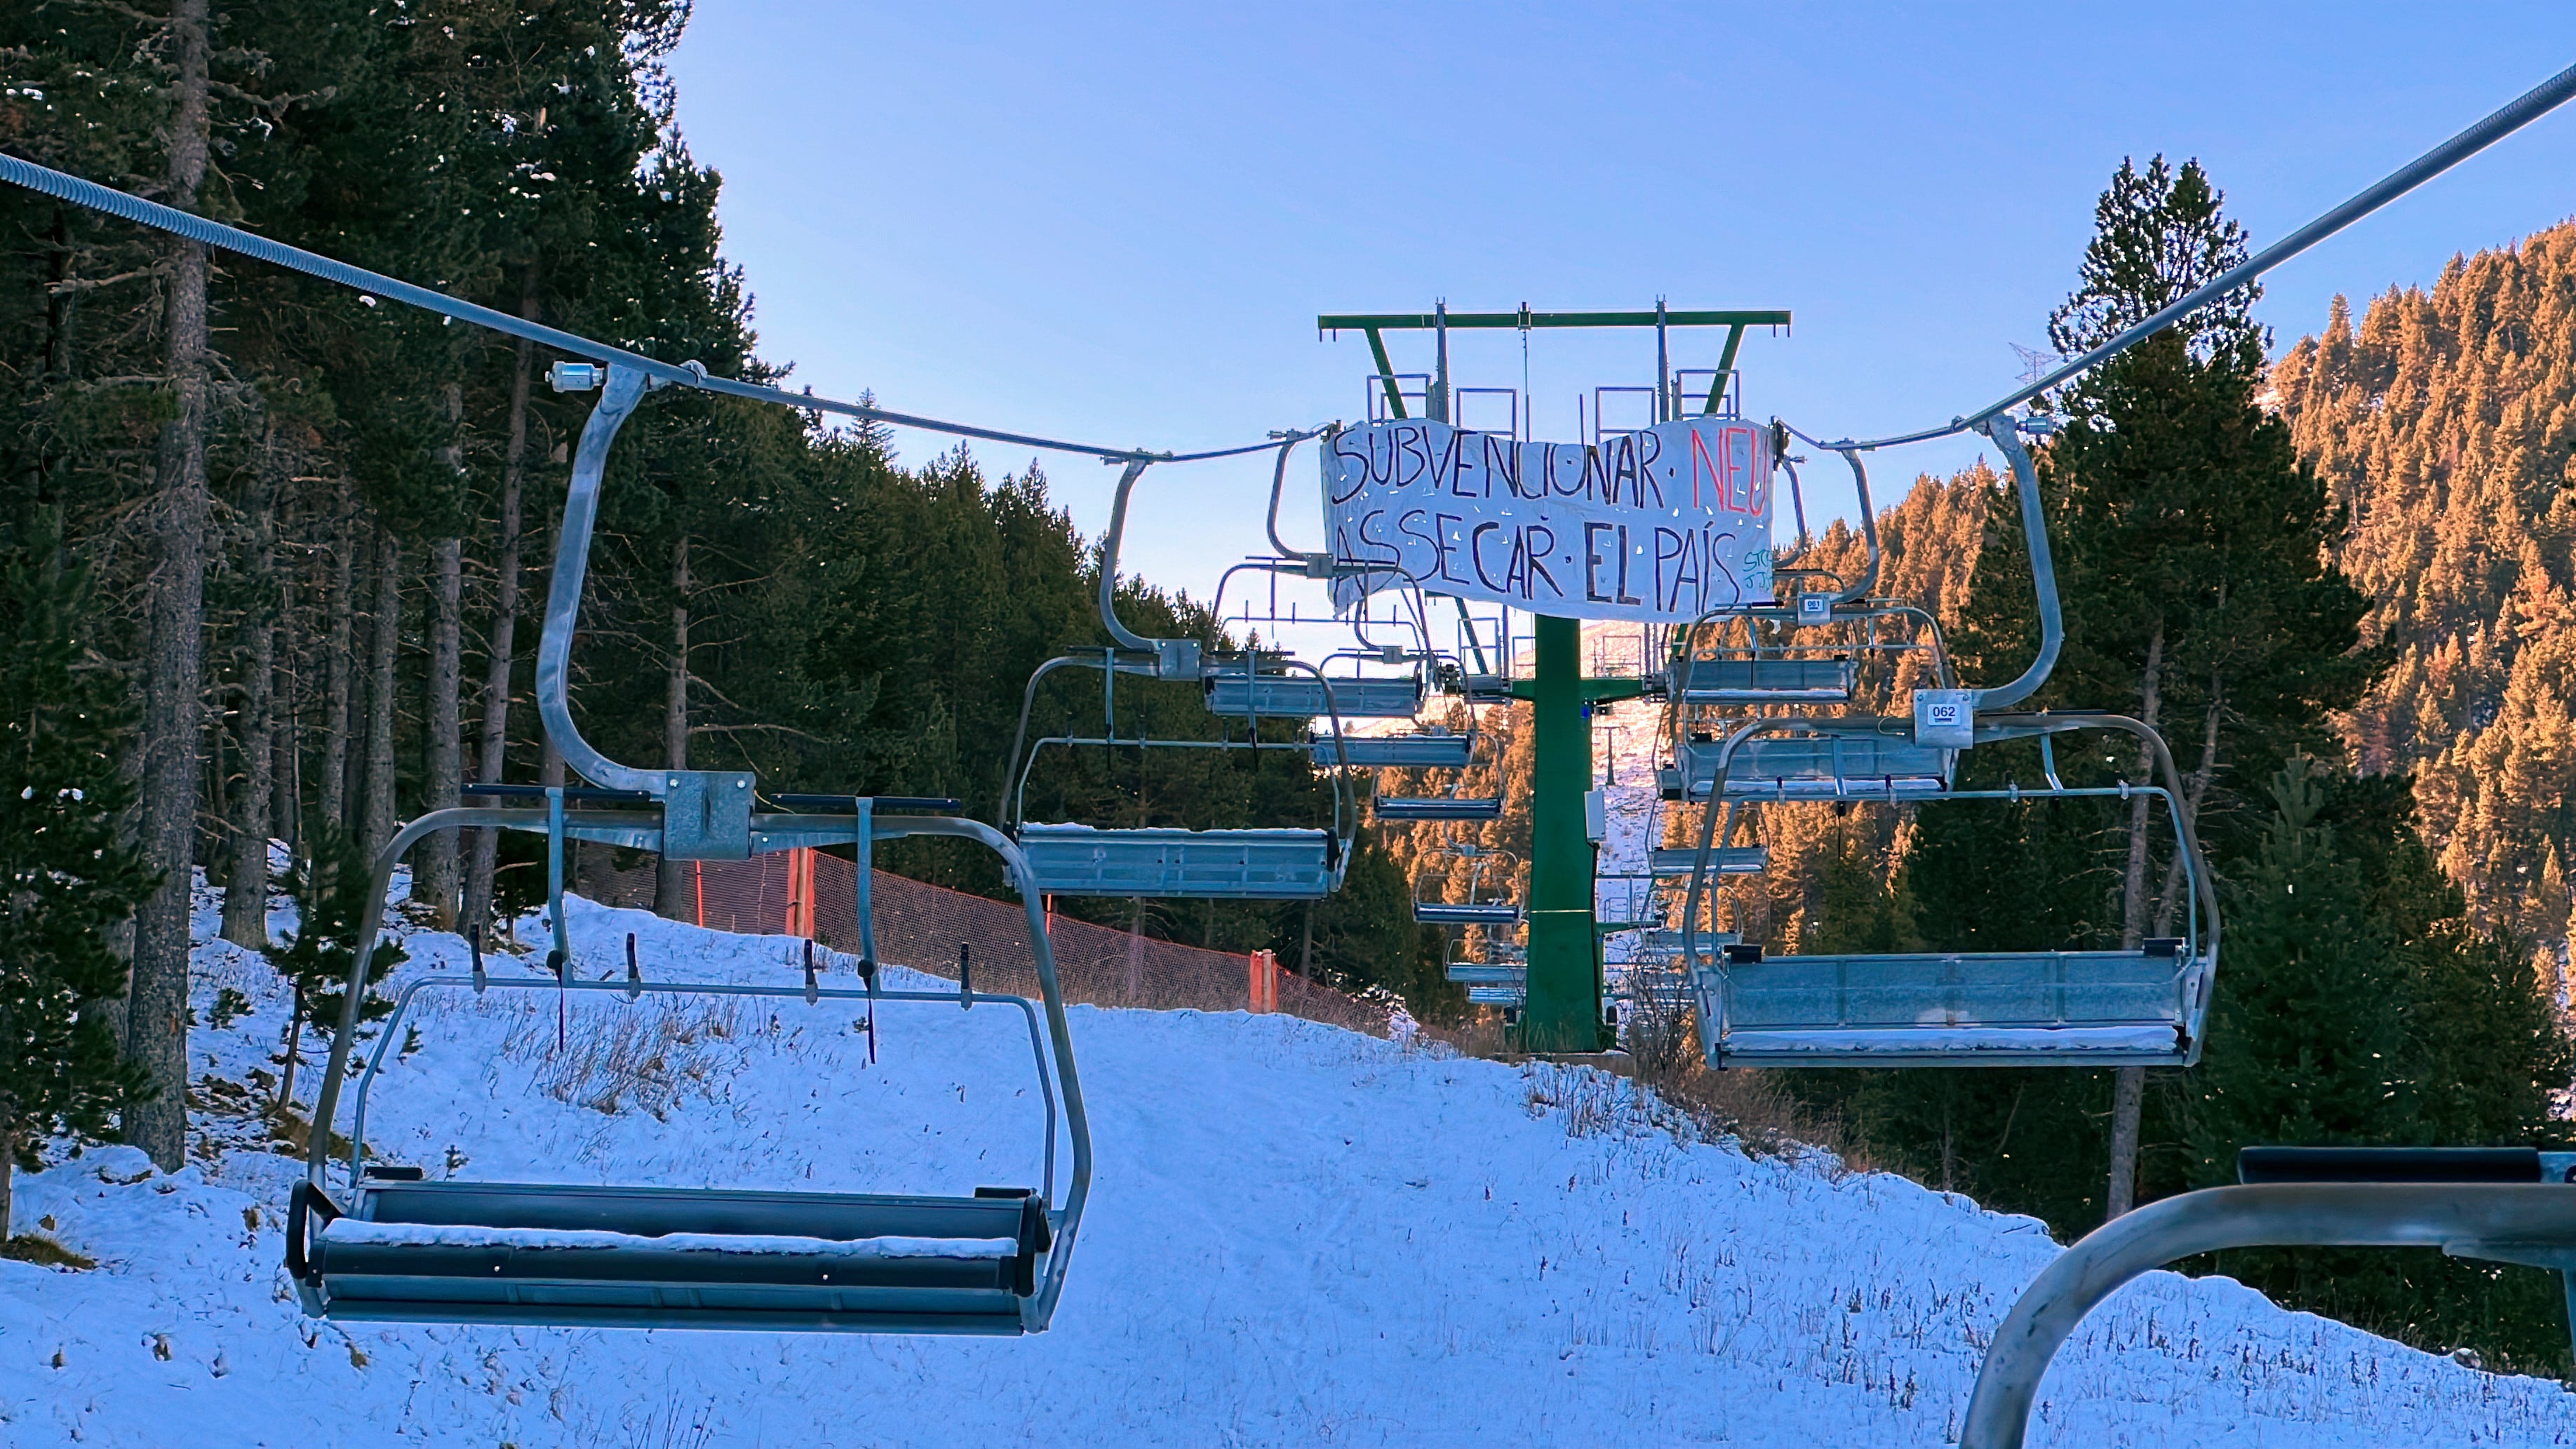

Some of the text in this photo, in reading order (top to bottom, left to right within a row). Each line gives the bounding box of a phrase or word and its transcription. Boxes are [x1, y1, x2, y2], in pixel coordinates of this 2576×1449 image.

[1691, 427, 1769, 517] NEU
[1583, 521, 1642, 606] EL
[1933, 706, 1956, 717] 062
